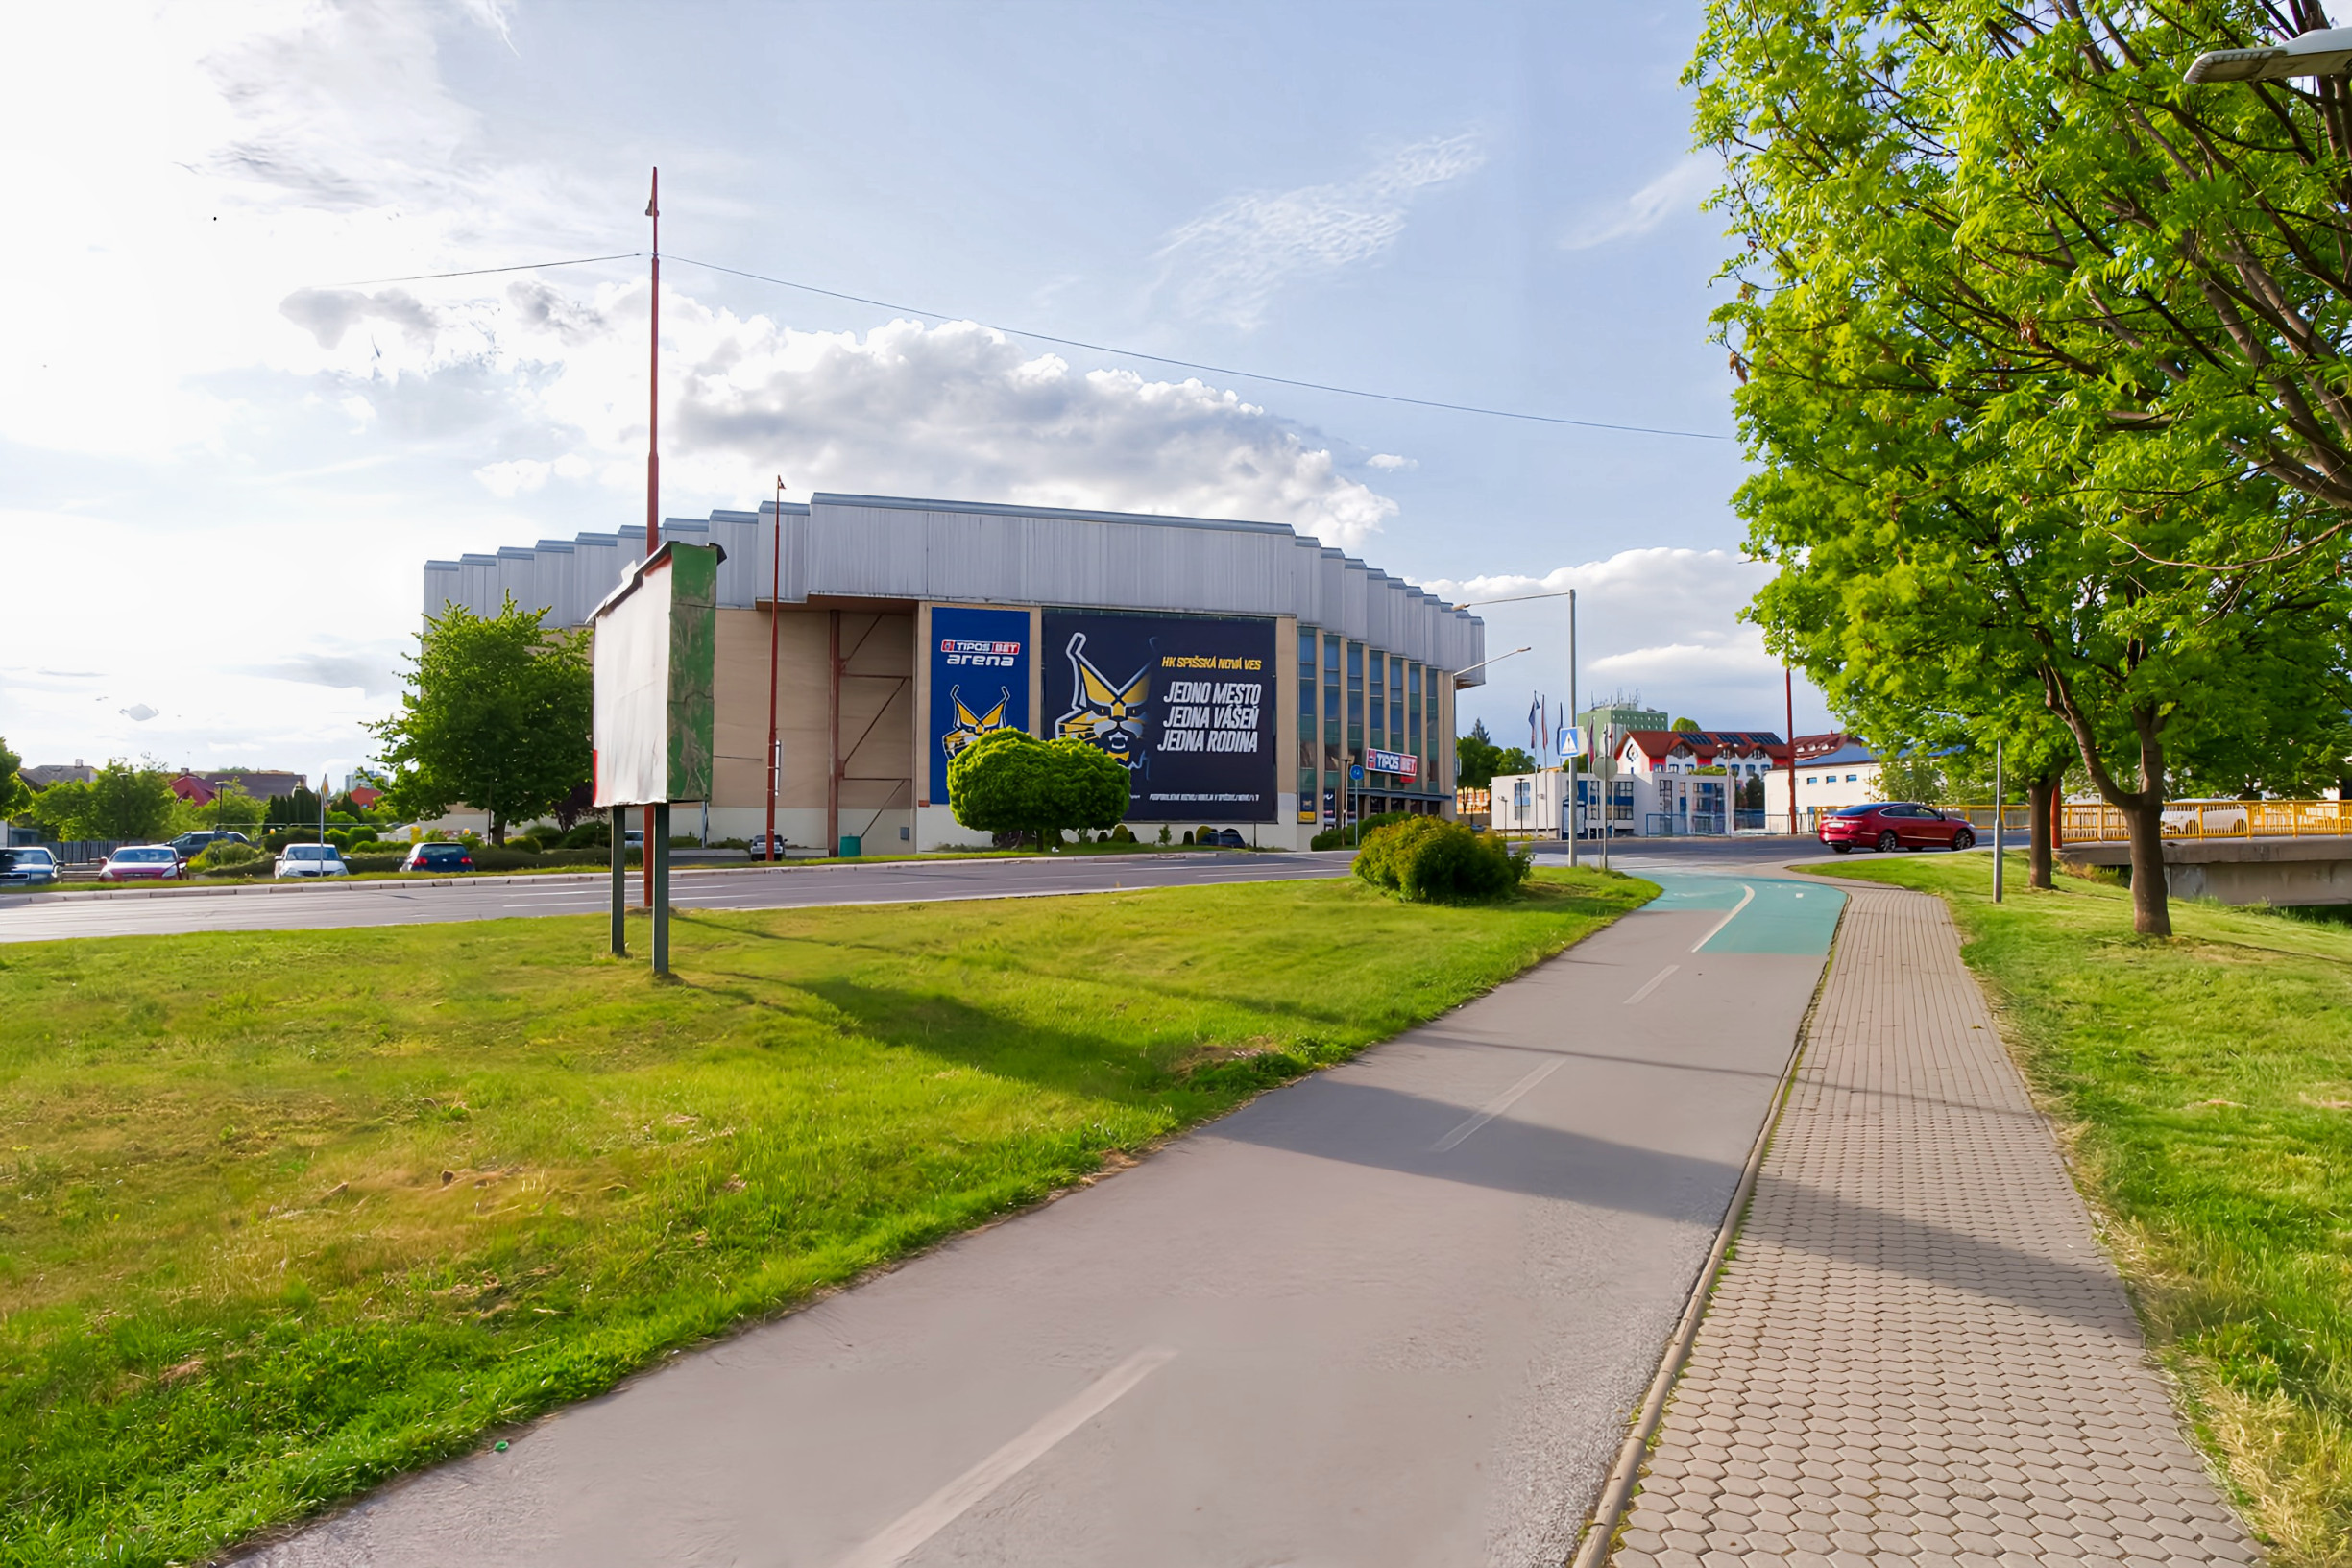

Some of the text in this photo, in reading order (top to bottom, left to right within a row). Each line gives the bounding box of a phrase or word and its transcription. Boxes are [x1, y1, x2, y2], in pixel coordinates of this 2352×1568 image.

[957, 642, 991, 652] TIPOS
[947, 654, 1015, 666] arena
[1162, 656, 1176, 667] HK
[1244, 659, 1262, 670] VES
[1163, 681, 1262, 705] JEDNO MESTO
[1162, 703, 1260, 730] JEDNA VÁŠEŇ
[1156, 729, 1259, 753] JEDNA RODINA
[1376, 752, 1399, 770] TIPOS
